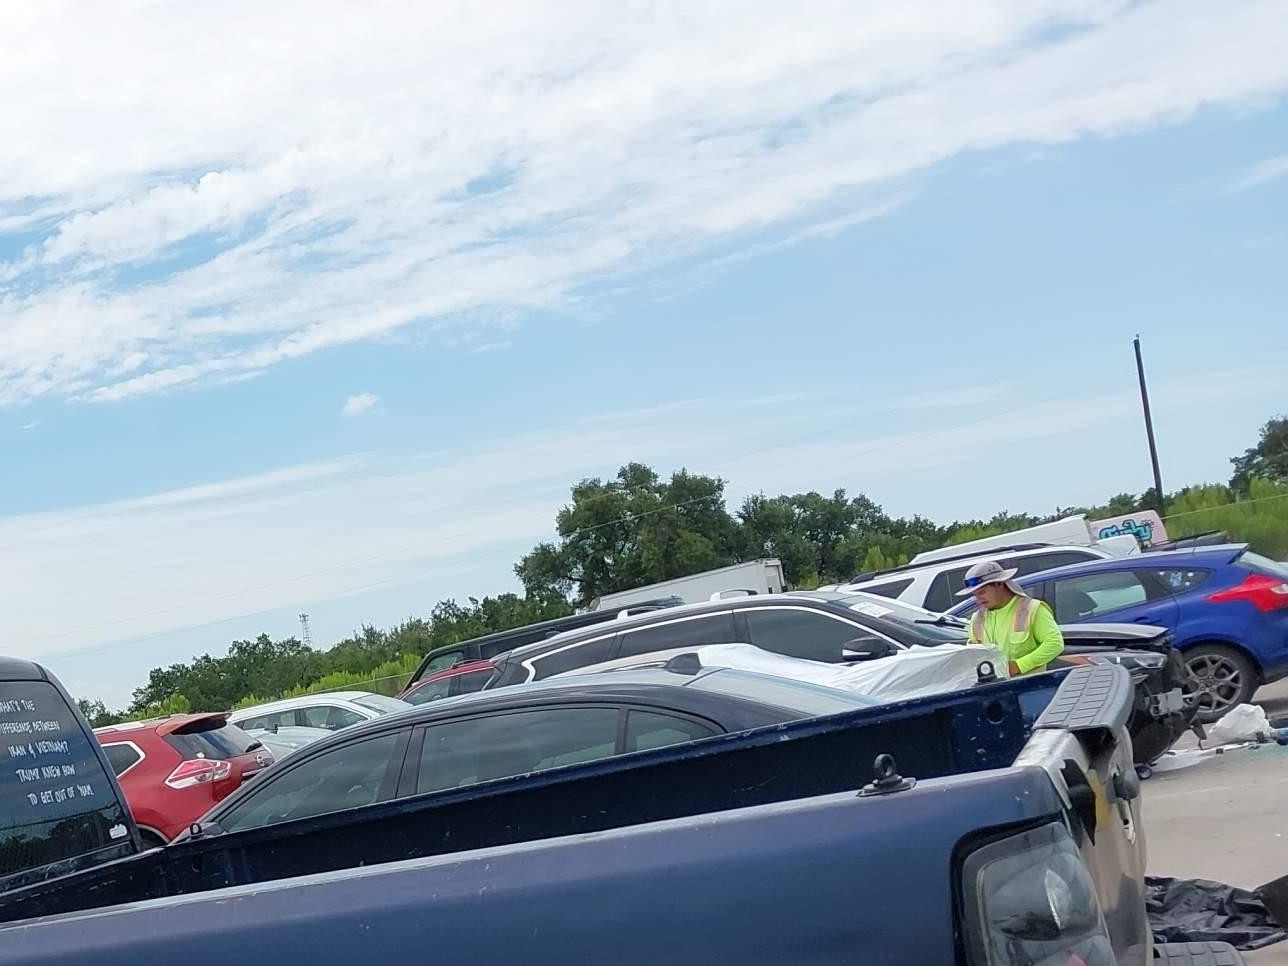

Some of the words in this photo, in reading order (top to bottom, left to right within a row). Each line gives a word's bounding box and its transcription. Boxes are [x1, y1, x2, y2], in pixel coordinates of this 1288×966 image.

[21, 700, 36, 711] THE
[32, 720, 60, 733] BETWEEN
[7, 745, 27, 758] IRAN
[16, 767, 40, 783] TRUMP
[41, 765, 61, 779] KNEW
[27, 793, 38, 806] TO
[40, 790, 54, 804] GET
[55, 788, 66, 803] OUT
[66, 786, 76, 799] OF
